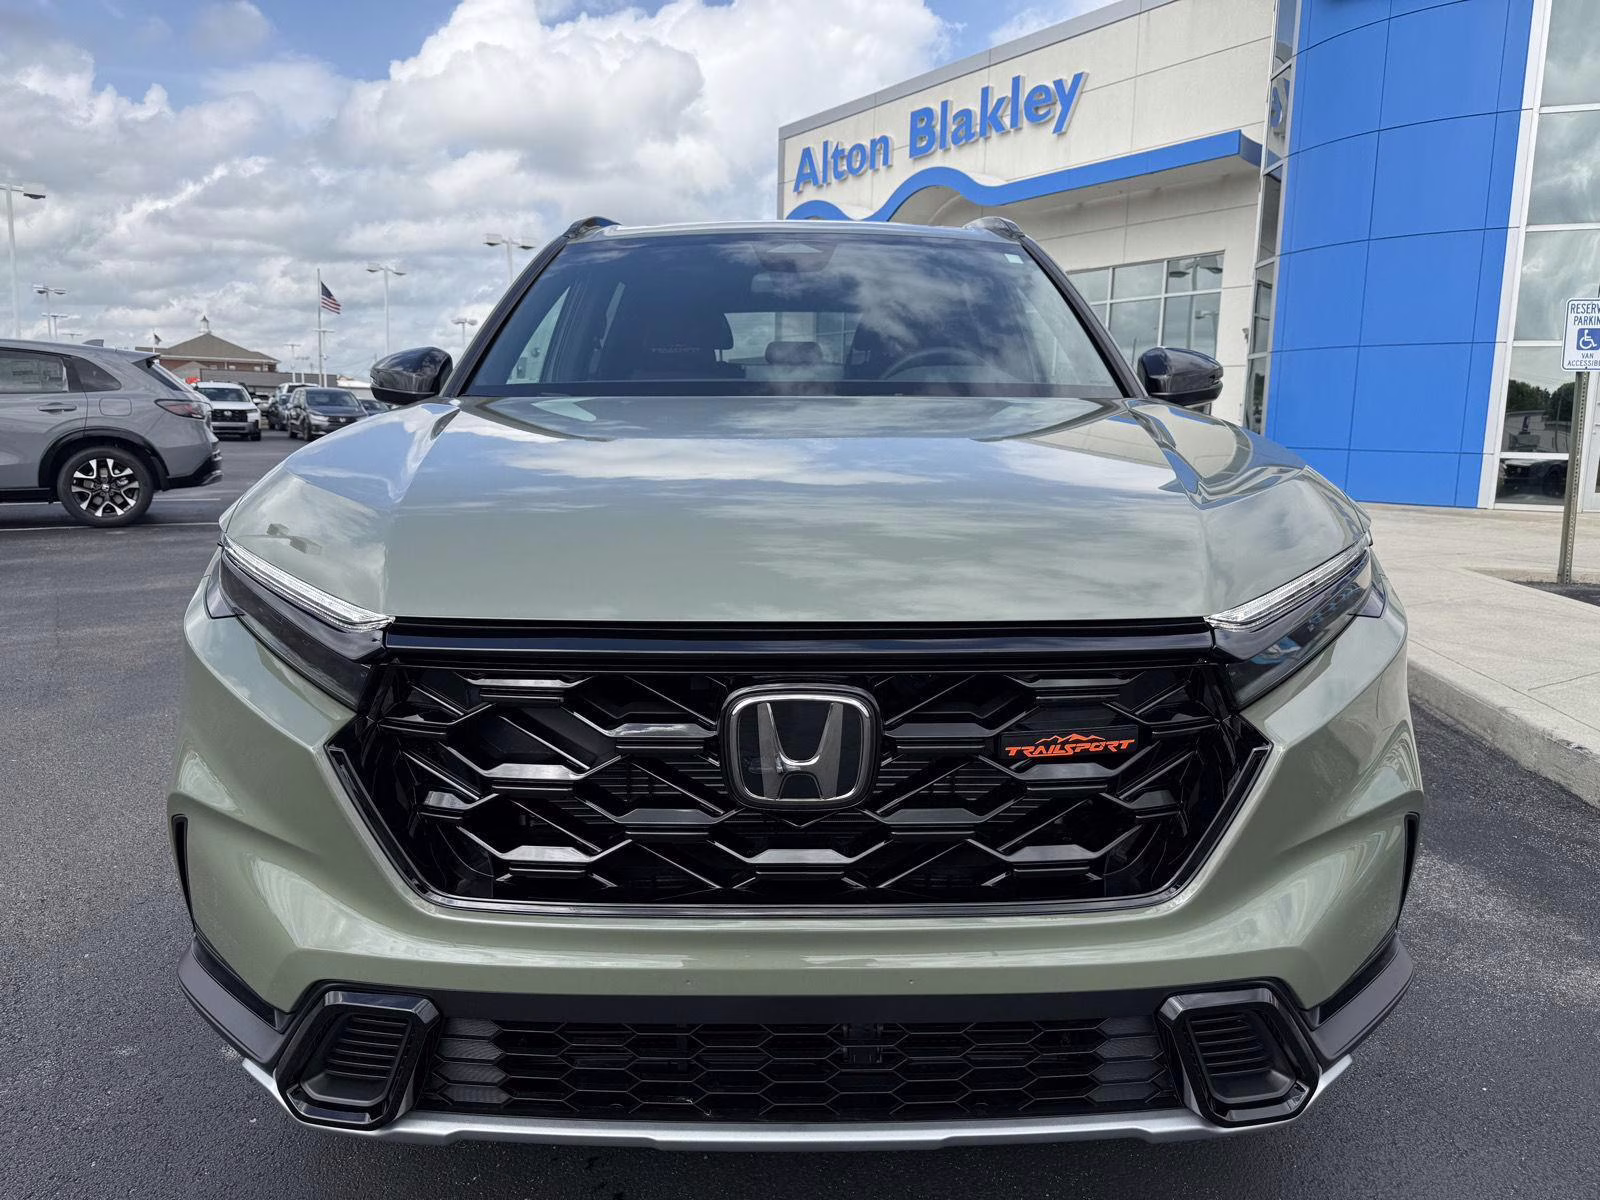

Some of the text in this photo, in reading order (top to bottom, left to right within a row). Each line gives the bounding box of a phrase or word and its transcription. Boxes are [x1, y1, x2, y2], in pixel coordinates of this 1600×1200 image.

[793, 71, 1089, 194] Alton Blakley
[1005, 739, 1135, 758] TRAILSPORT
